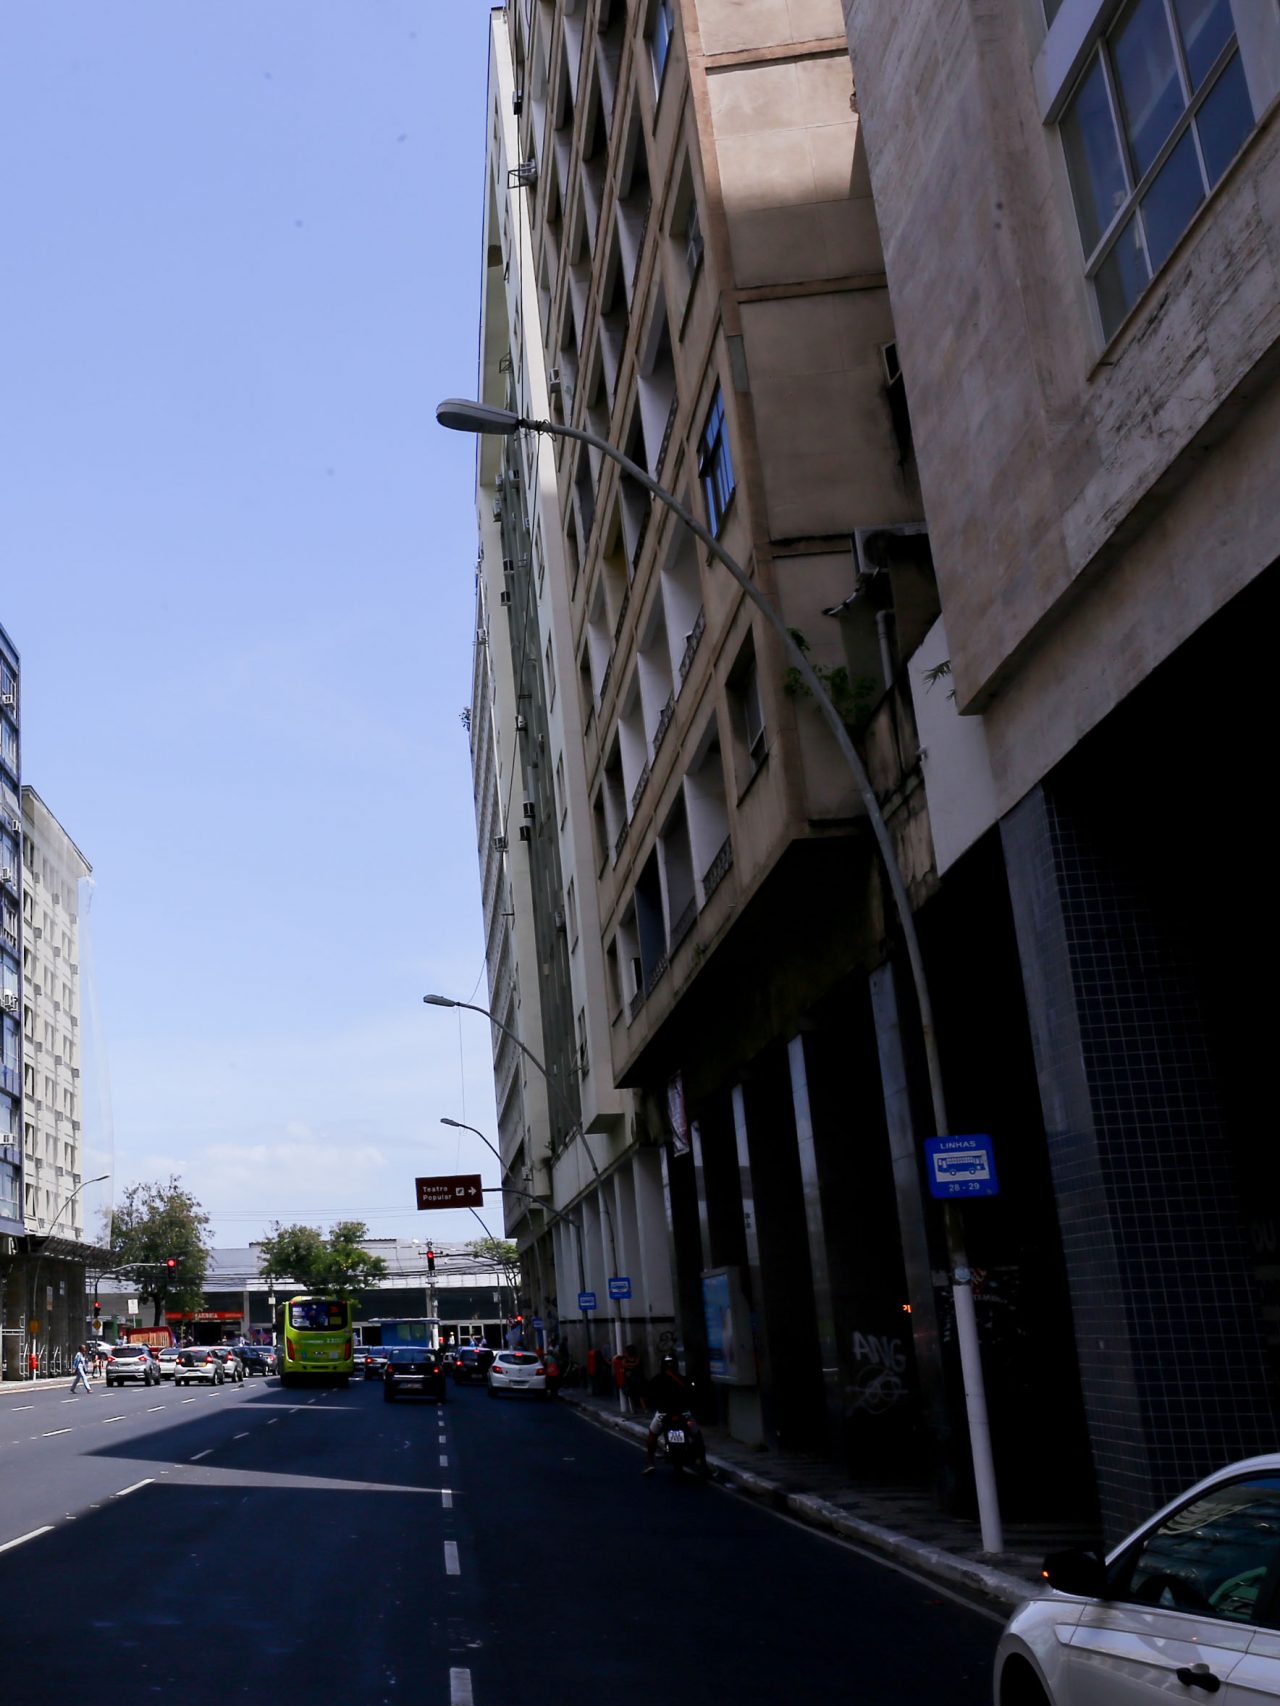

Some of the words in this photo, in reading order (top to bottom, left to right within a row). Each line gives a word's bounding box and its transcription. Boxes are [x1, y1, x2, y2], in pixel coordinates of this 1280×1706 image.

[940, 1140, 977, 1150] LINHAS
[948, 1183, 961, 1192] 28
[968, 1182, 980, 1191] 29
